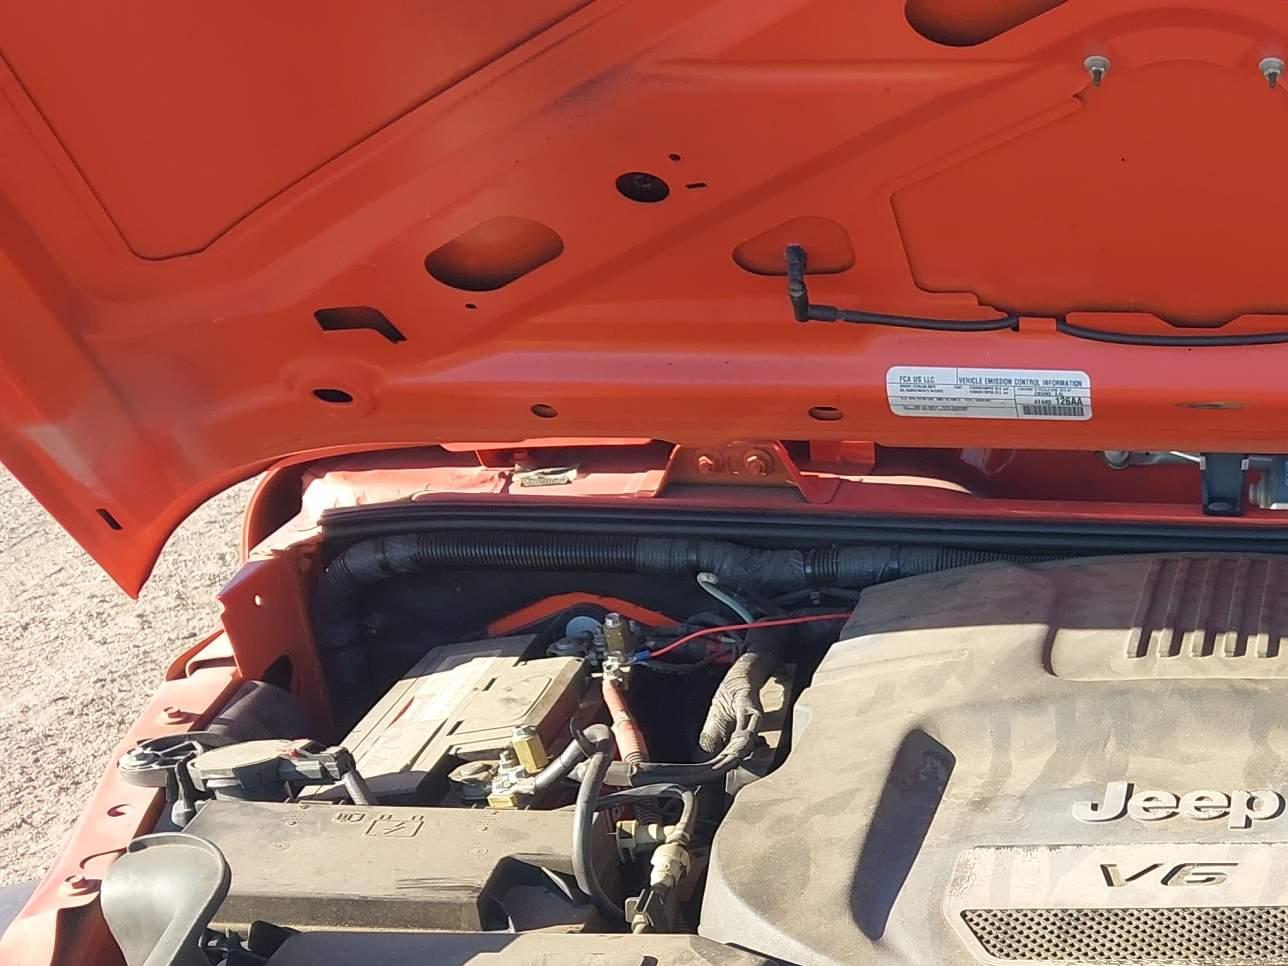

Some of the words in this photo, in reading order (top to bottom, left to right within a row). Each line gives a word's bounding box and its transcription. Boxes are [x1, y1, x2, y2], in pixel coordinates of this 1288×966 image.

[899, 375, 911, 383] FCA
[958, 376, 983, 385] VEHICLE
[984, 377, 1012, 386] EMISSION
[1014, 378, 1040, 386] CONTROL
[1042, 379, 1082, 387] INFORMATION
[1054, 397, 1084, 406] 126AA
[1072, 781, 1287, 830] Jeep
[1100, 862, 1240, 888] V6
